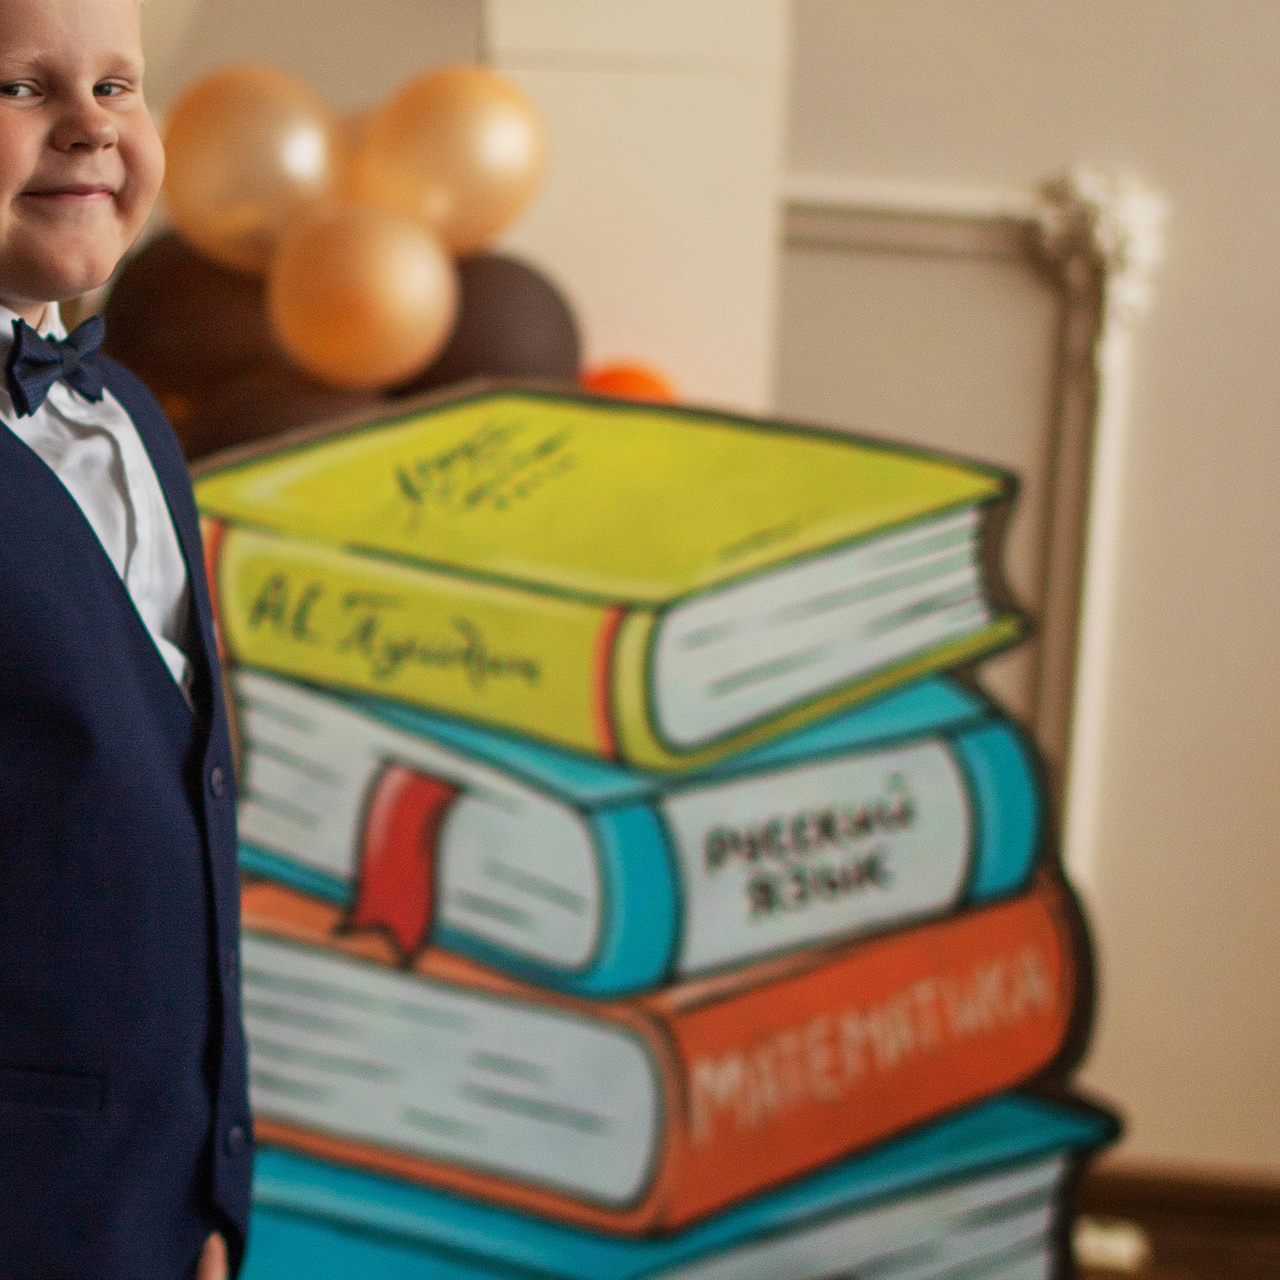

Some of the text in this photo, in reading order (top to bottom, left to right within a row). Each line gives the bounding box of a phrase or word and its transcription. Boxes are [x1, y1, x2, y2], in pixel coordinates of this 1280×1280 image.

[704, 772, 916, 873] РУССКИЙ
[747, 846, 892, 920] ЯЗЫК
[690, 944, 1055, 1150] МАТЕМАТИКА
